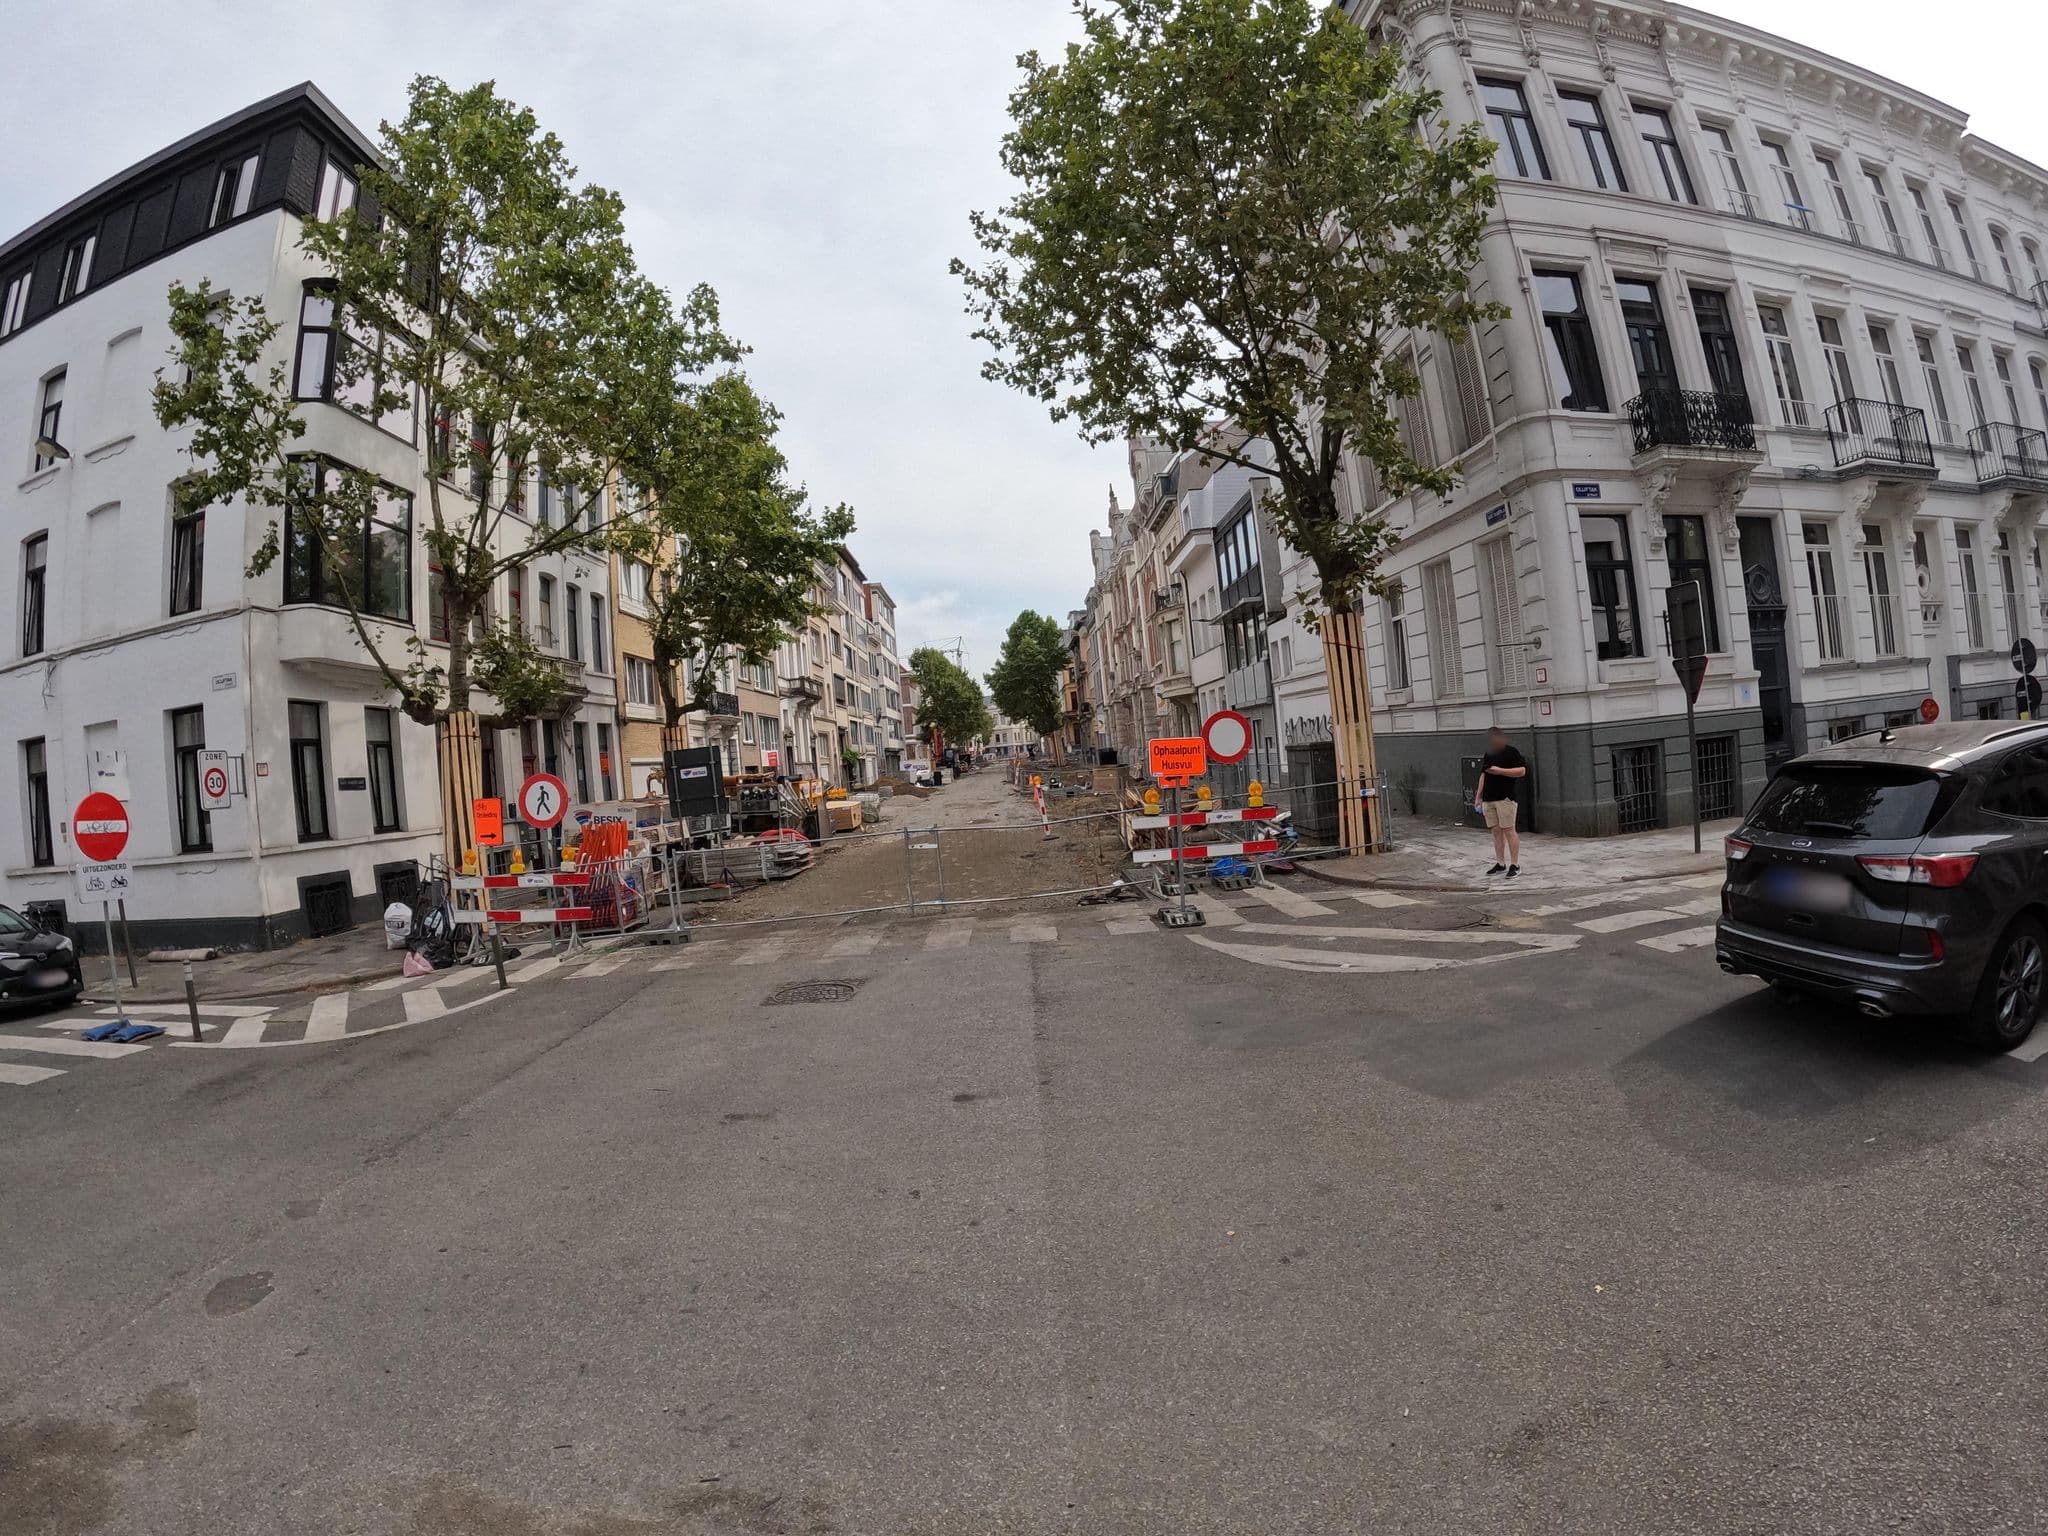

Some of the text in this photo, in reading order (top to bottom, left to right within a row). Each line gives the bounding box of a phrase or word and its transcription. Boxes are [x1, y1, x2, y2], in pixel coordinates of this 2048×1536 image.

[1154, 745, 1200, 758] Ophaalpunt
[205, 753, 222, 761] ZONE
[209, 777, 222, 788] 30
[593, 816, 622, 824] BESIX
[82, 863, 127, 873] UITGEZONDERD
